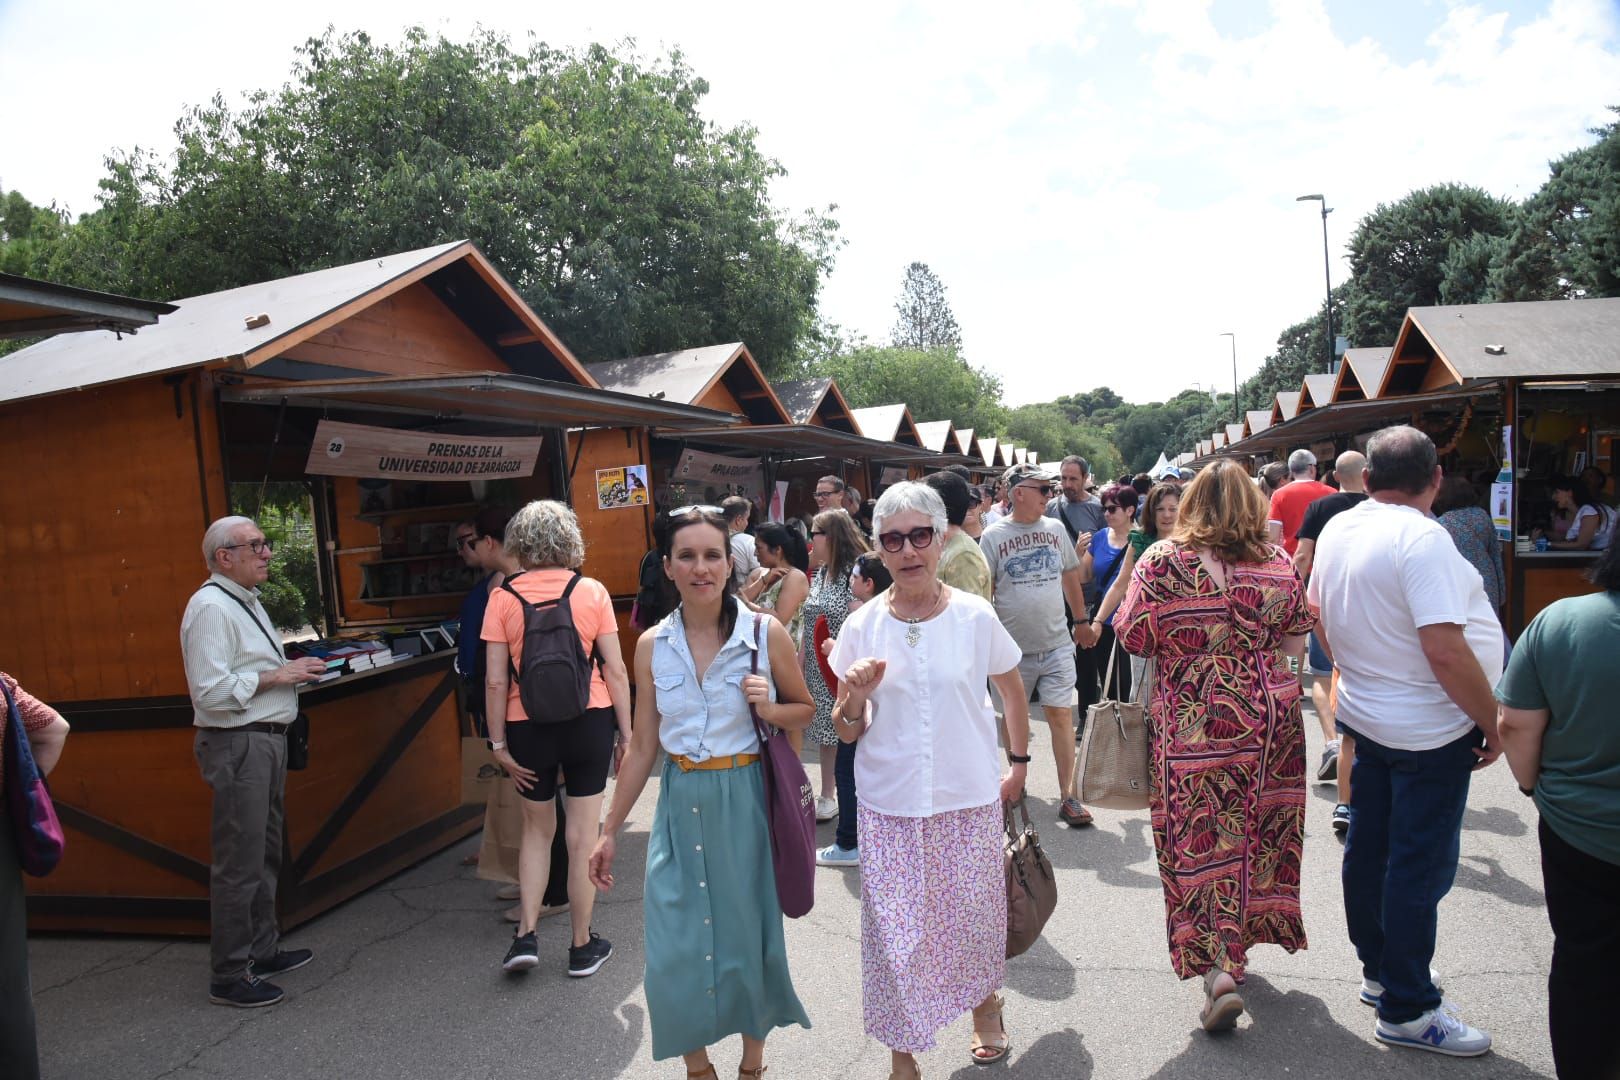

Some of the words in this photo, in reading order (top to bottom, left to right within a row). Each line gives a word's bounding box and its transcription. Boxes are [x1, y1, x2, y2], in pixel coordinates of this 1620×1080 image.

[329, 442, 342, 453] 28
[427, 442, 478, 458] PRENSAS
[478, 445, 492, 458] DE
[492, 445, 504, 458] LA
[379, 456, 463, 475] UNIVERSIDAD
[464, 461, 478, 474] DE
[478, 460, 521, 474] ZARAGOZA
[998, 534, 1031, 559] HARD
[1032, 532, 1060, 550] ROCK
